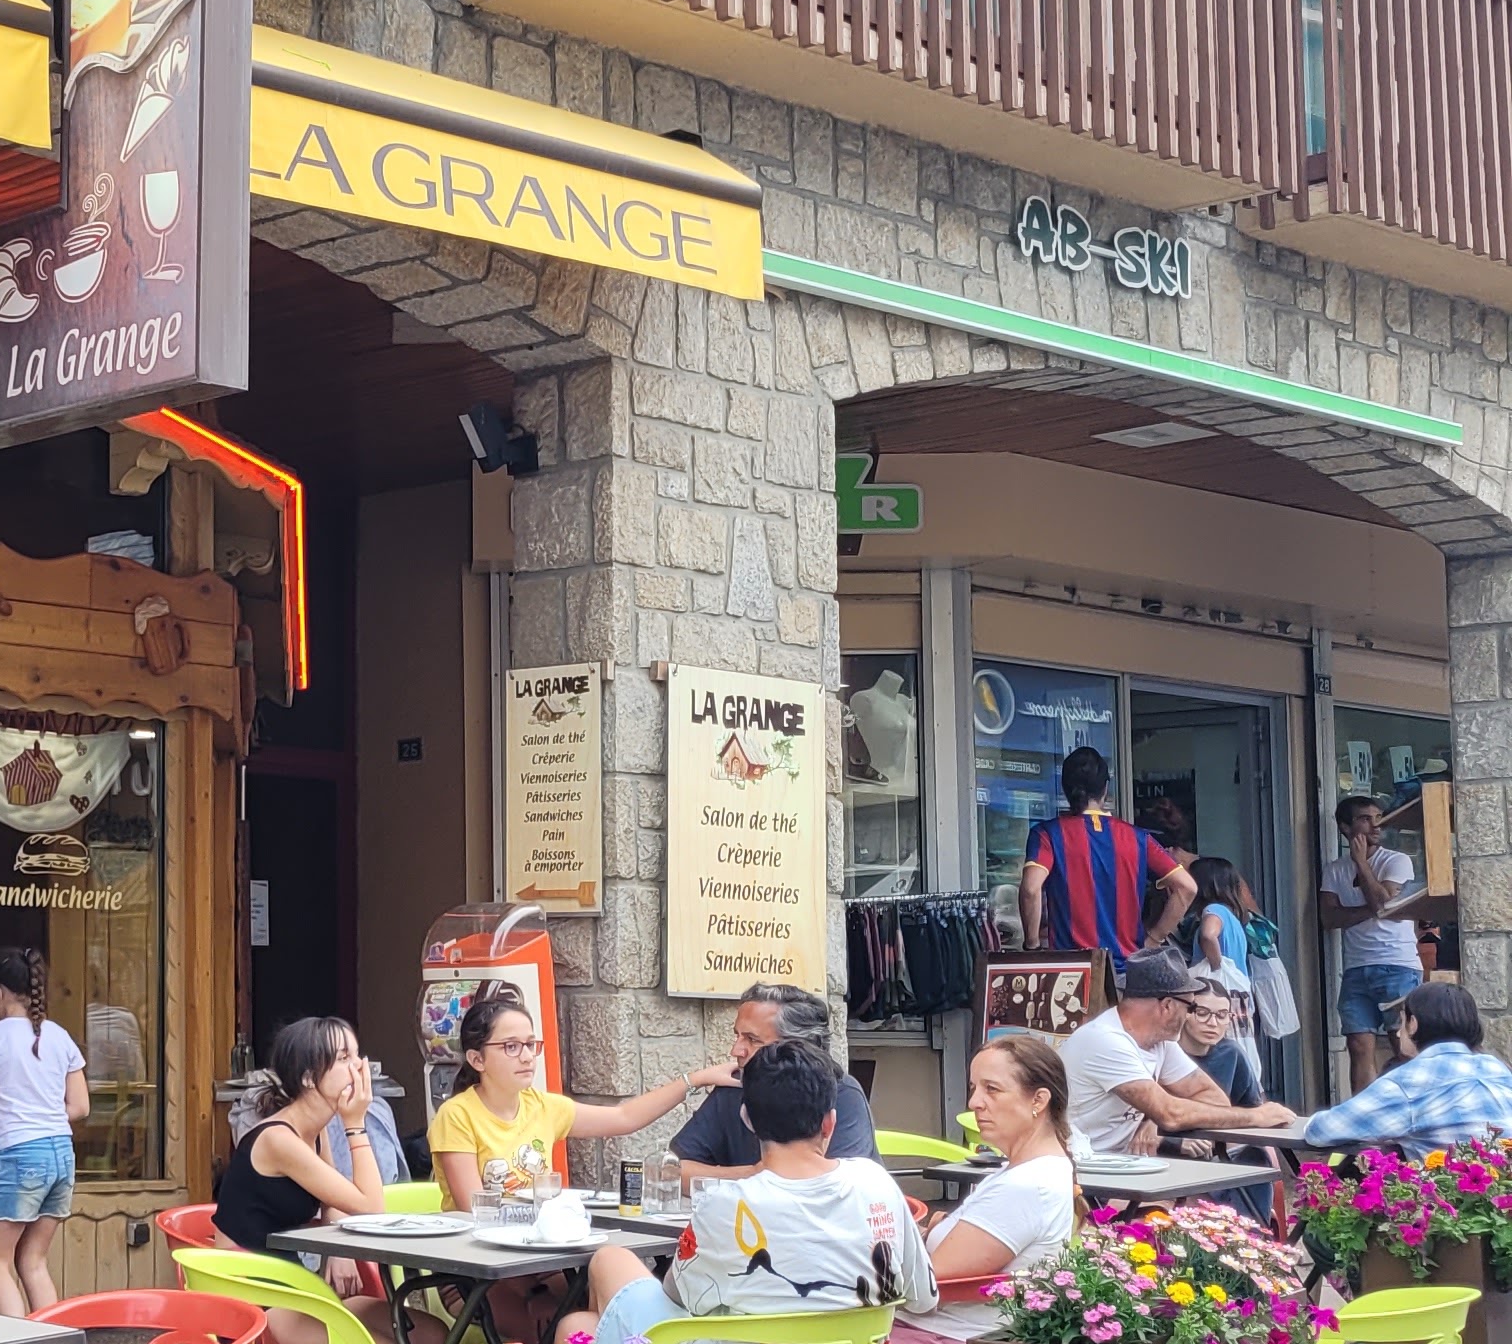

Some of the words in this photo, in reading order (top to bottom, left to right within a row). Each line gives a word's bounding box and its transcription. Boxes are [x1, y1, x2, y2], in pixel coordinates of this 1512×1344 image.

[371, 143, 718, 276] GRANGE
[7, 344, 47, 398] La
[56, 312, 183, 386] Grange
[516, 680, 533, 698] LA
[534, 675, 590, 698] GRANGE
[691, 688, 718, 725] LA
[722, 695, 806, 737] GRANGE
[521, 734, 549, 747] Salon
[552, 733, 566, 745] de
[568, 729, 586, 744] thé
[520, 769, 587, 785] Viennoiseries
[525, 789, 582, 804] Pâtisseries
[524, 809, 583, 823] Sandwiches
[700, 805, 745, 829] Salon
[749, 811, 768, 831] de
[772, 812, 799, 834] thé
[541, 827, 565, 842] Pain
[524, 859, 531, 873] à
[534, 860, 584, 874] emporter
[531, 848, 576, 862] Boissons
[699, 876, 800, 905] Viennoiseries
[707, 912, 791, 940] Pâtisseries
[703, 949, 794, 976] Sandwiches
